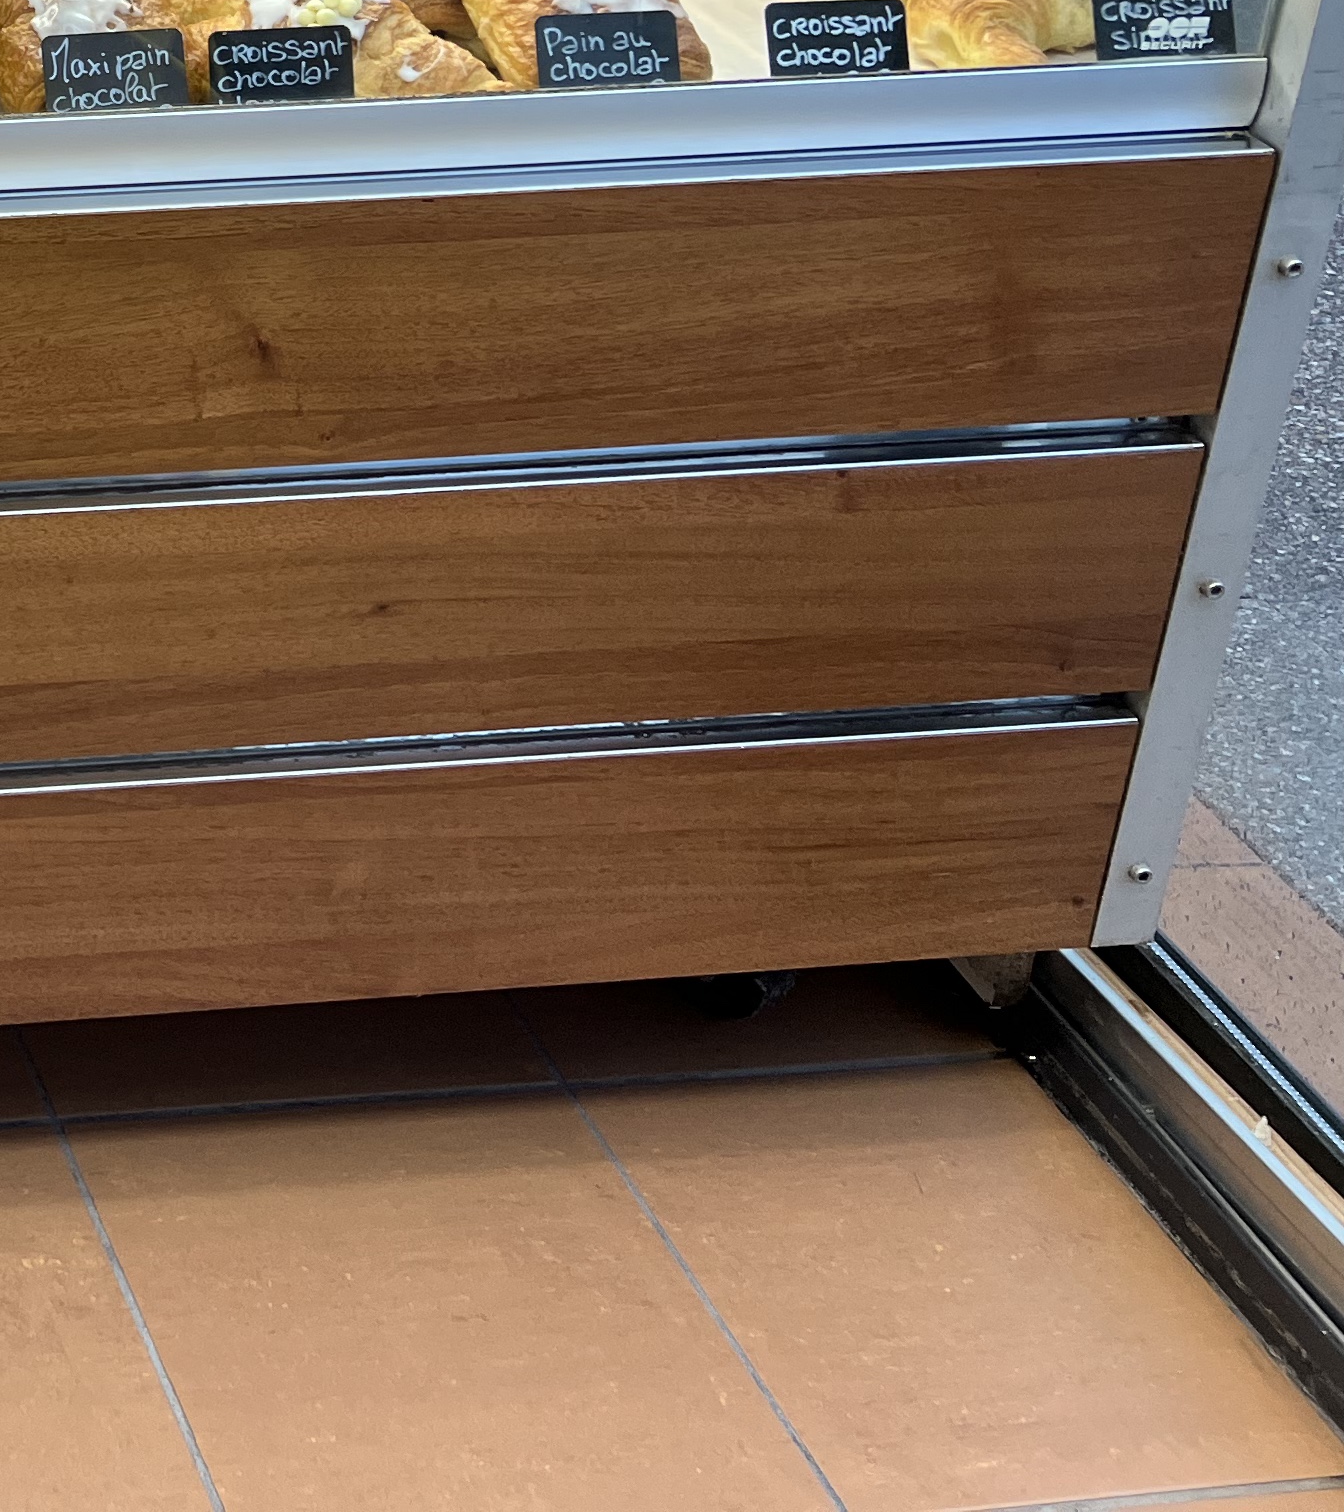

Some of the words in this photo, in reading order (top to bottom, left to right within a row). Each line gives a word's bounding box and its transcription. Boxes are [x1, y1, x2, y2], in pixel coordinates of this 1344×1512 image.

[543, 27, 605, 57] Pain
[612, 31, 652, 51] au
[776, 37, 892, 68] chocolat
[116, 43, 170, 81] pain
[217, 60, 340, 93] chocolat
[549, 49, 670, 82] chocolat
[52, 72, 169, 114] chocolat
